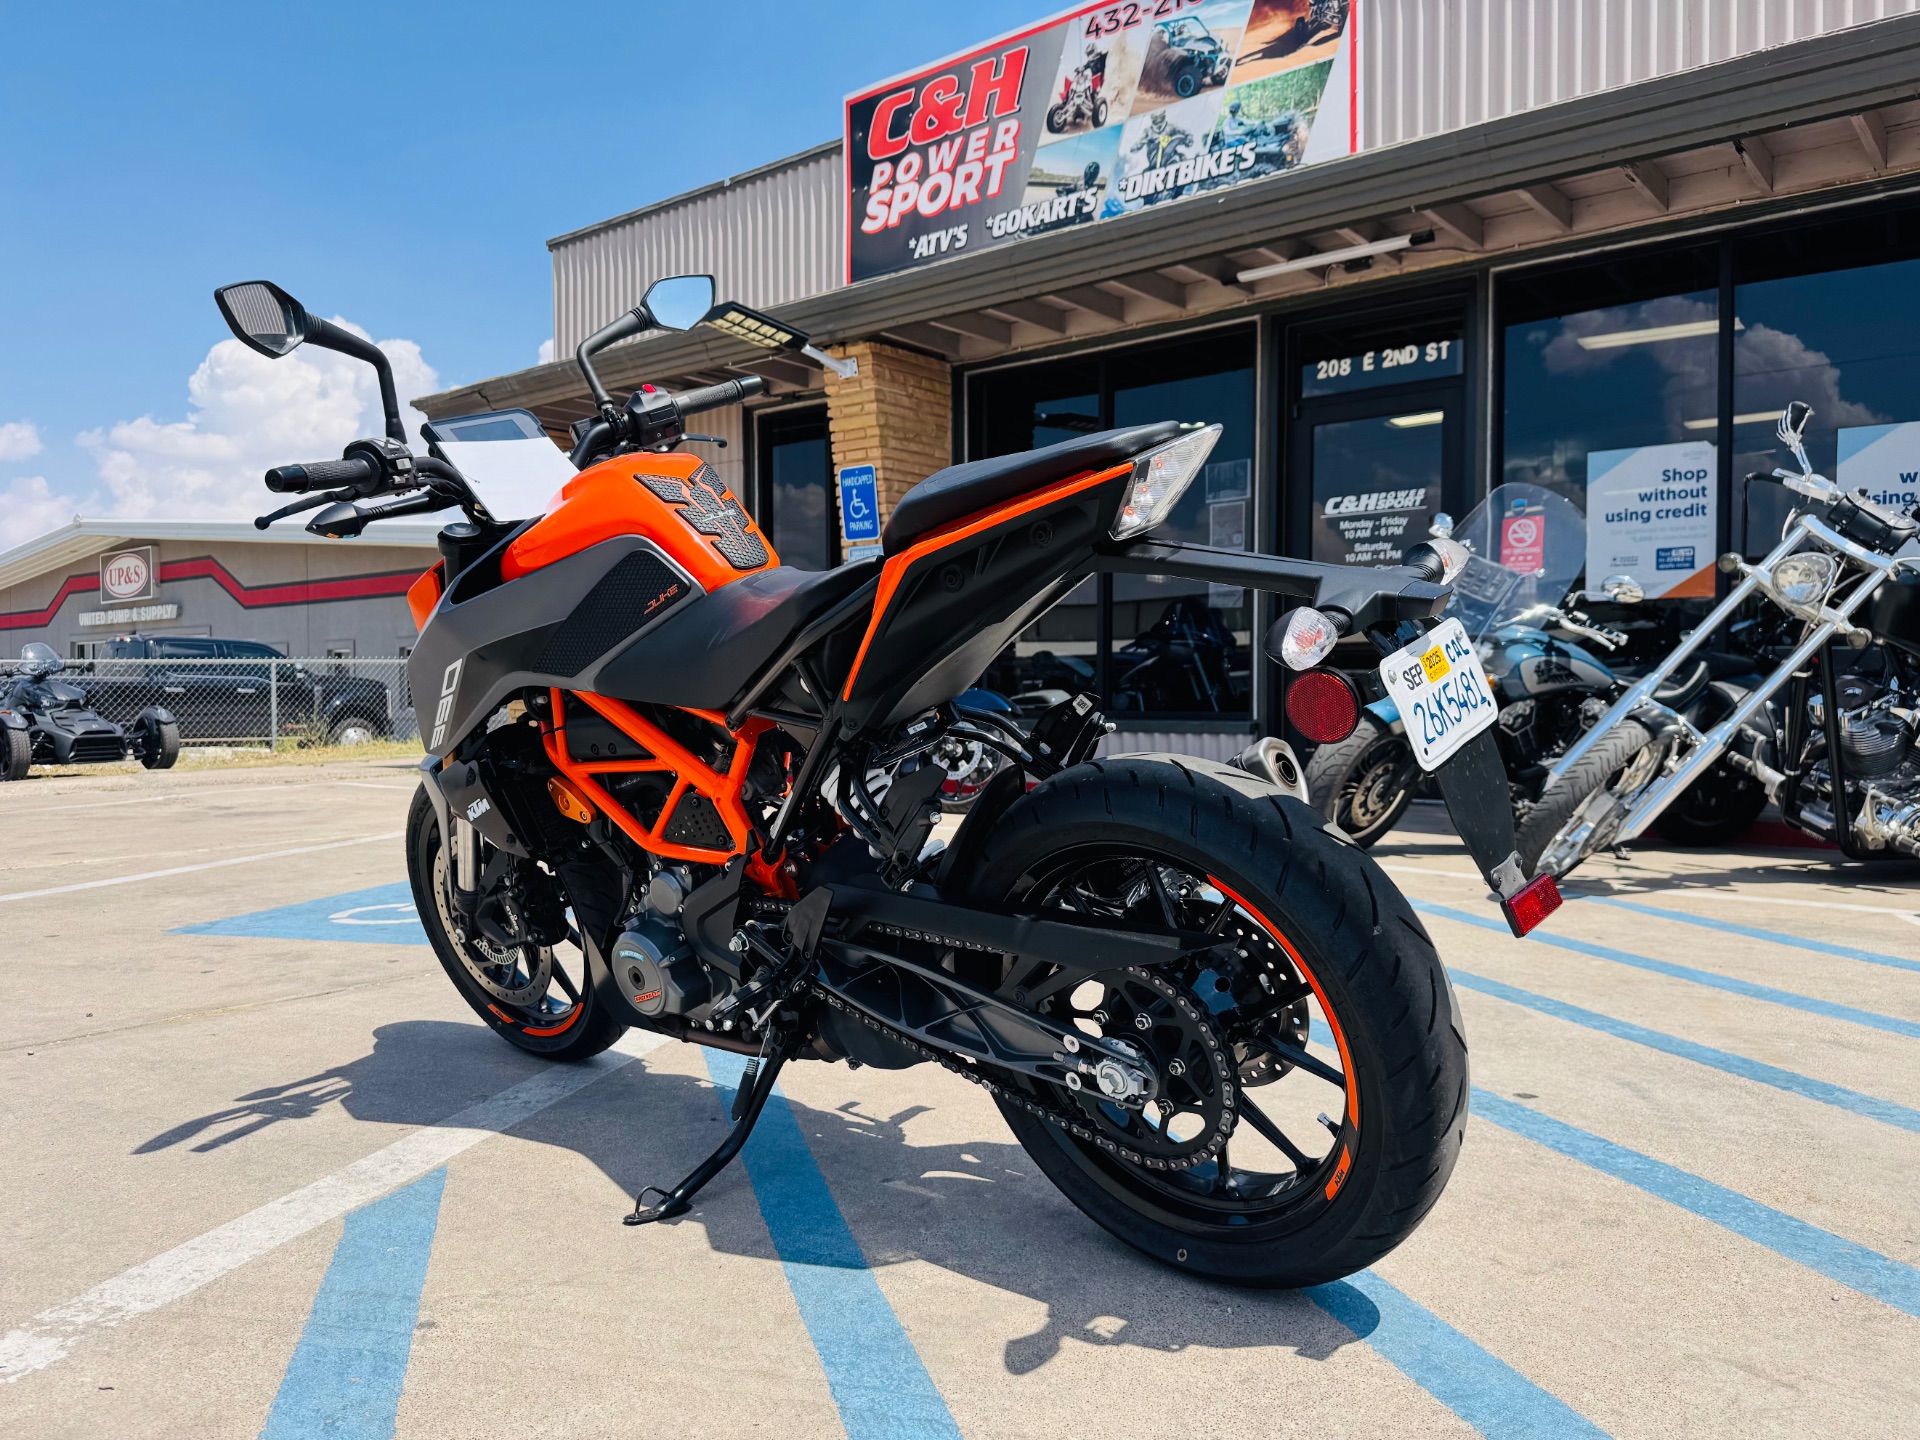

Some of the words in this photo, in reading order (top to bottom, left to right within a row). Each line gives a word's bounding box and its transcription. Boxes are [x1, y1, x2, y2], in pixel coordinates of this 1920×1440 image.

[868, 45, 1030, 160] C&H
[869, 118, 1021, 195] POWER
[861, 148, 1018, 234] SPORT
[1317, 358, 1351, 379] 208
[1363, 351, 1374, 371] E
[1381, 345, 1418, 368] 2ND
[1425, 340, 1450, 362] ST
[843, 474, 872, 487] HANDICAPPED
[1662, 468, 1707, 483] Shop
[1379, 488, 1426, 500] POWER
[1639, 485, 1707, 502] without
[1867, 490, 1915, 507] sing
[1324, 493, 1380, 515] C&H
[1376, 498, 1422, 510] SPORT
[1605, 508, 1651, 523] using
[1655, 503, 1707, 519] credit
[850, 520, 873, 531] PARKING
[1339, 520, 1374, 530] Monday
[1381, 516, 1409, 527] Friday
[1344, 530, 1355, 539] 10
[1355, 529, 1371, 538] AM
[1380, 526, 1386, 536] 6
[1388, 526, 1403, 535] PM
[1345, 553, 1355, 562] 10
[1356, 552, 1372, 561] AM
[1378, 552, 1385, 560] 4
[1386, 550, 1402, 559] PM
[1354, 541, 1393, 552] Saturday
[109, 565, 140, 586] UP&S
[644, 584, 678, 614] DUKE
[79, 611, 106, 626] UNITED
[108, 609, 130, 624] PUMP
[132, 607, 139, 621] &
[140, 604, 171, 621] SUPPLY
[1425, 651, 1442, 669] 2025
[1403, 663, 1424, 691] SEP
[430, 658, 463, 750] 390
[1414, 667, 1487, 744] 26K5481
[466, 798, 491, 822] KTM
